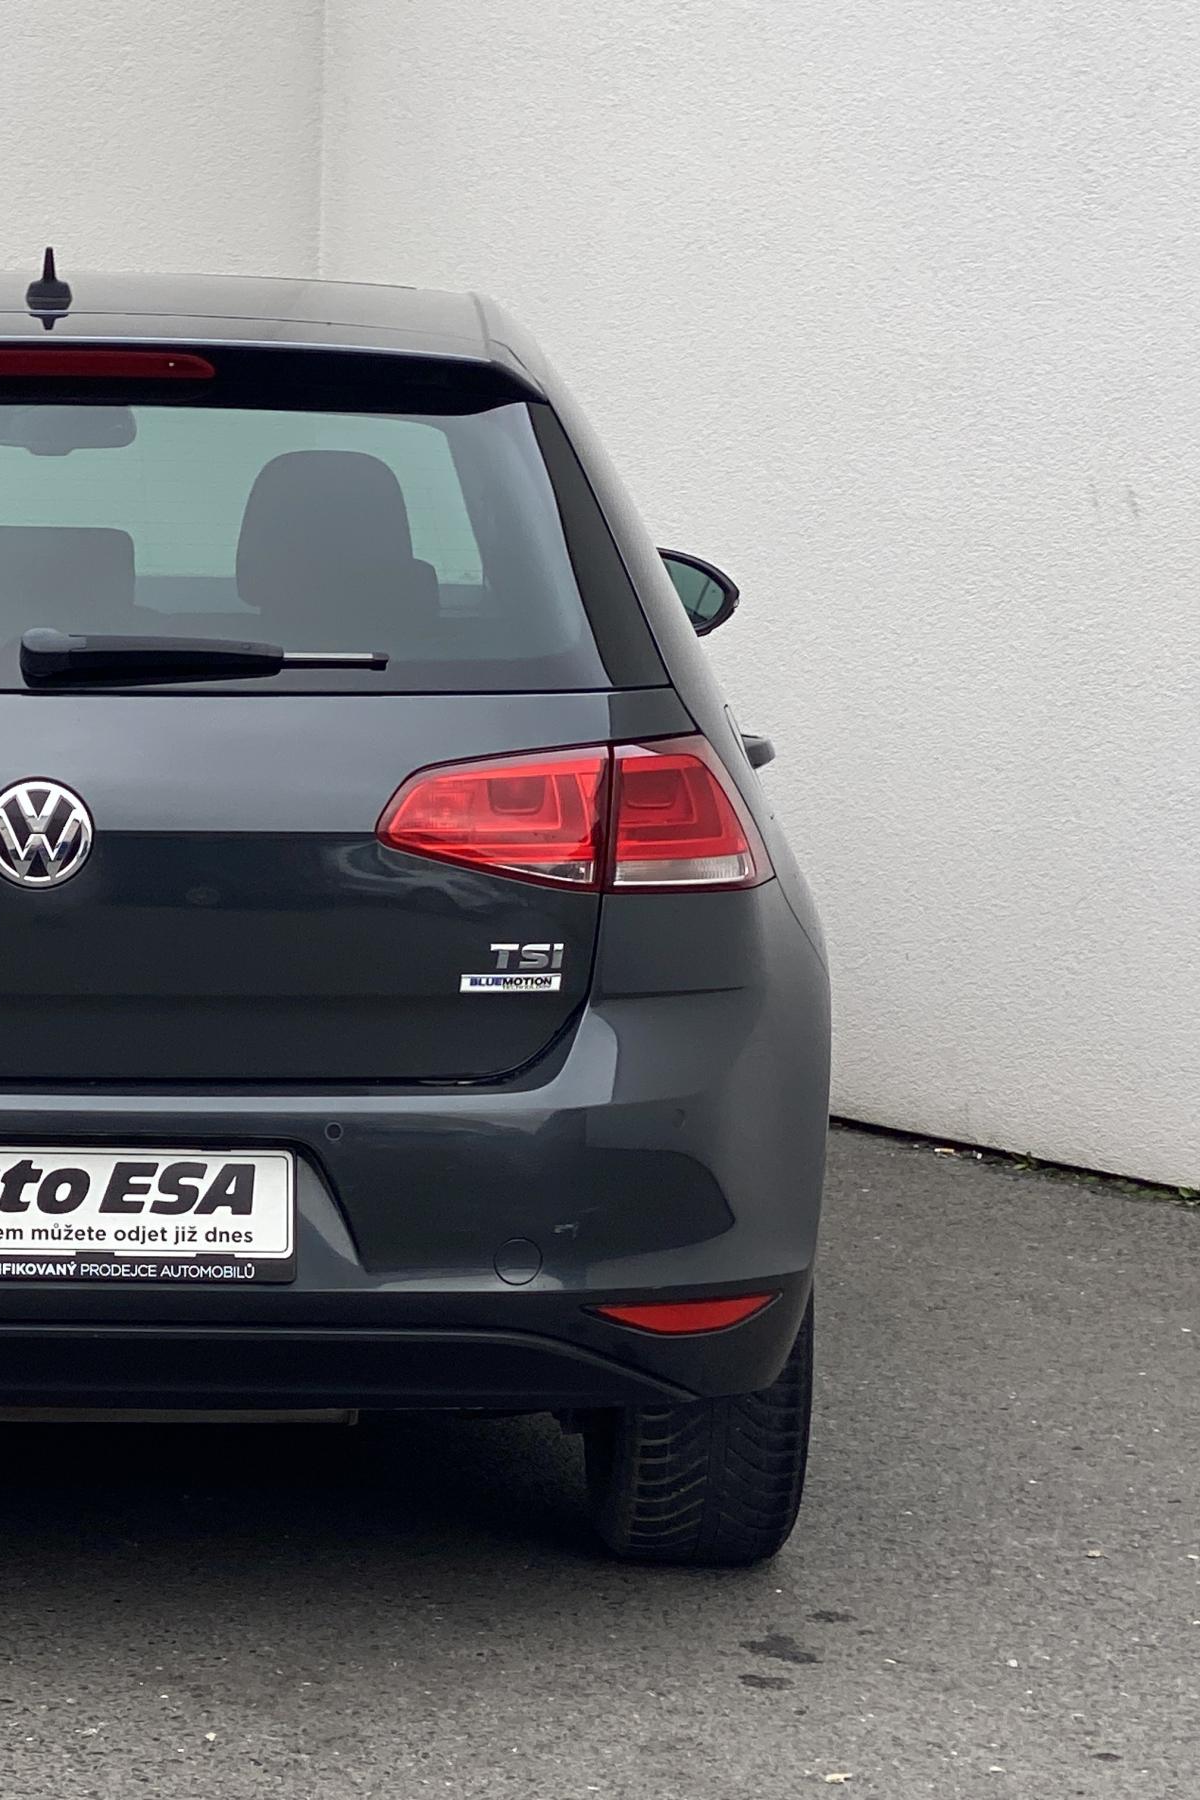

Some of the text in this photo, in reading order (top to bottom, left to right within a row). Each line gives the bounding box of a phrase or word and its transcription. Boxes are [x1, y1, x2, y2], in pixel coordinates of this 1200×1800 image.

[490, 943, 564, 969] TSI
[468, 976, 552, 987] BLUEMOTION
[98, 1162, 255, 1215] ESA
[31, 1222, 107, 1241] můžete
[114, 1226, 167, 1244] odjet
[173, 1224, 197, 1245] již
[204, 1227, 253, 1243] dnes
[80, 1263, 157, 1278] PRODEJCE
[160, 1262, 256, 1279] AUTOMOBILŮ
